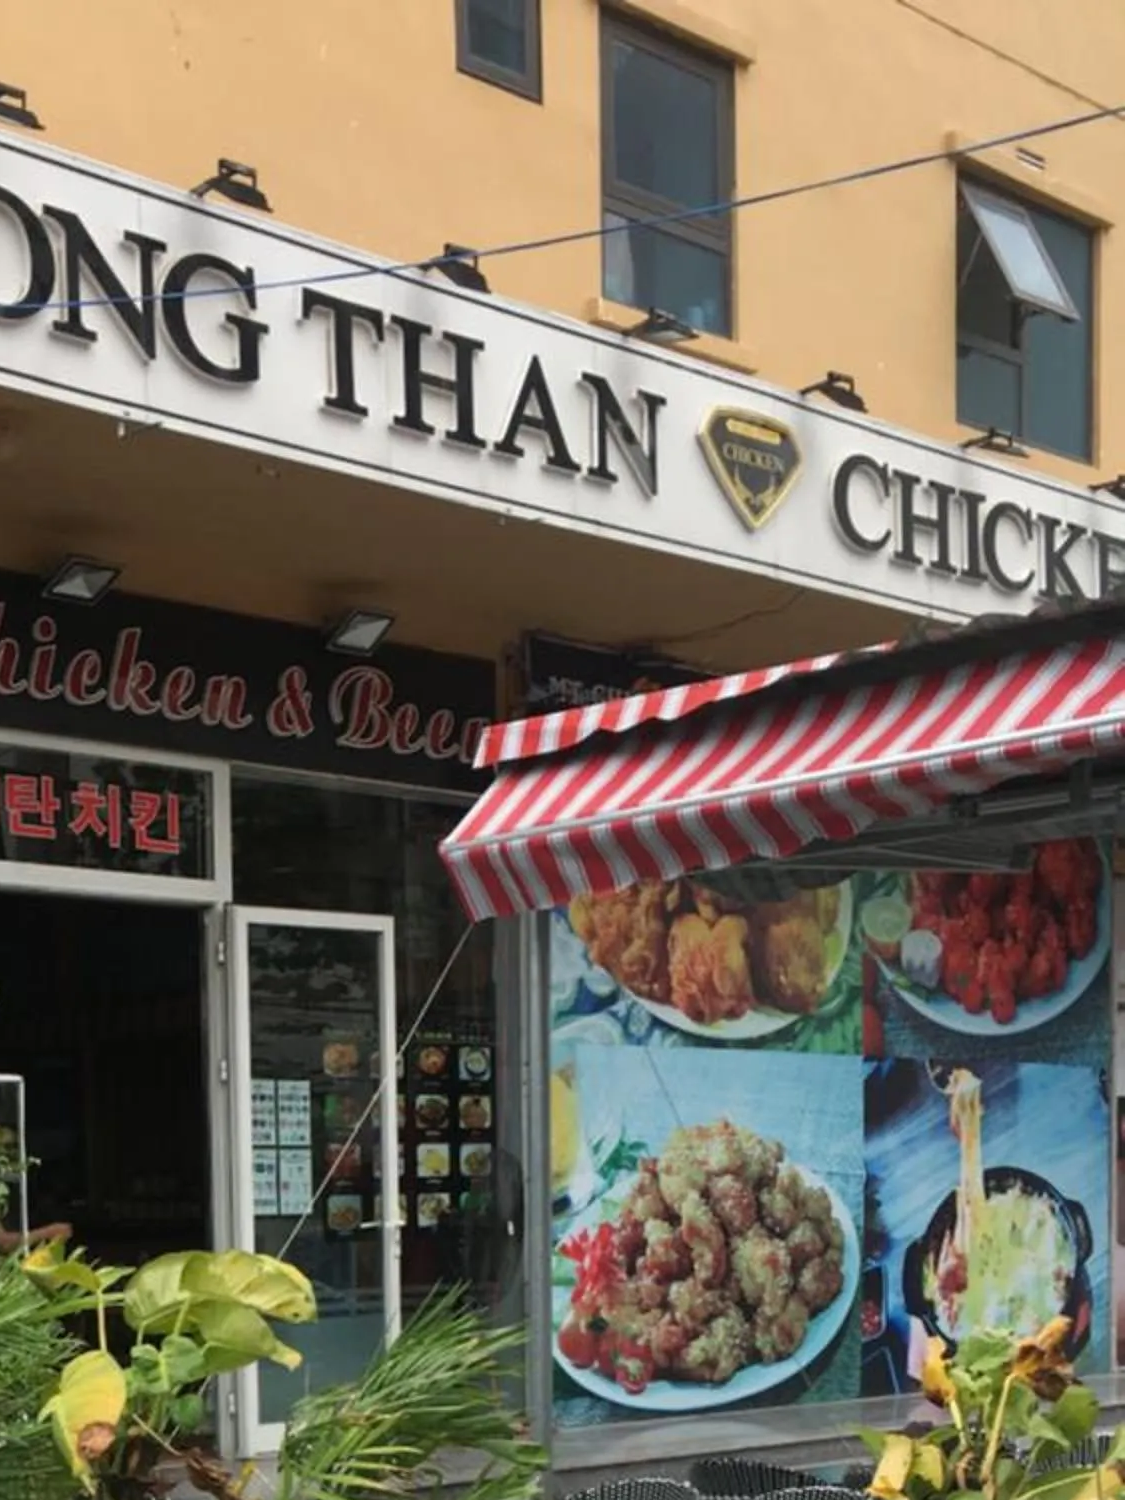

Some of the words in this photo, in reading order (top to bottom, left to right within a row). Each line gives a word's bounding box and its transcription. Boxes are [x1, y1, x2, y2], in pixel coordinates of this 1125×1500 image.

[301, 287, 669, 497] THAN
[266, 665, 315, 739] &
[69, 781, 181, 855] 치킨
